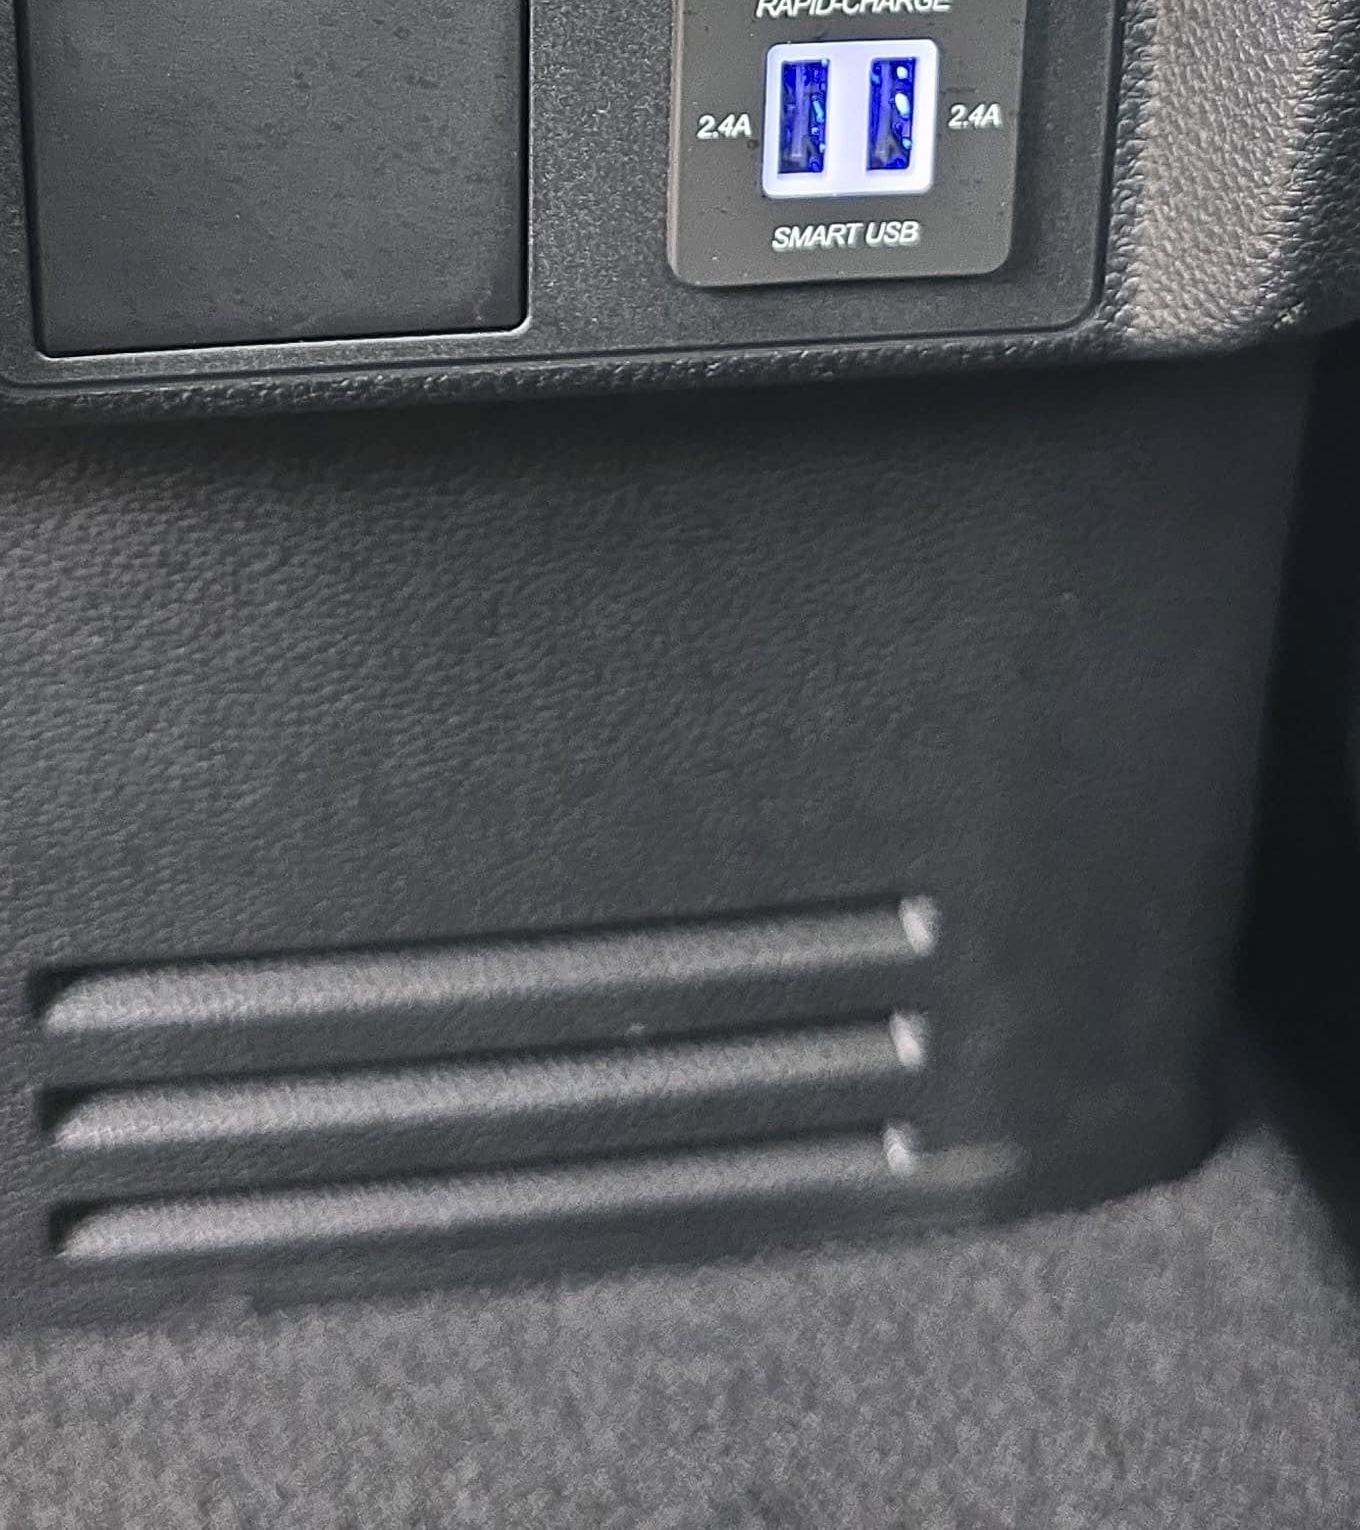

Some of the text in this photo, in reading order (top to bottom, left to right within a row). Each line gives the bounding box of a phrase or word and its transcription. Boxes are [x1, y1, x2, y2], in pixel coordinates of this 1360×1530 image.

[697, 113, 752, 139] 2.4A
[948, 103, 1002, 129] 2.4A
[772, 221, 921, 251] SMART USB
